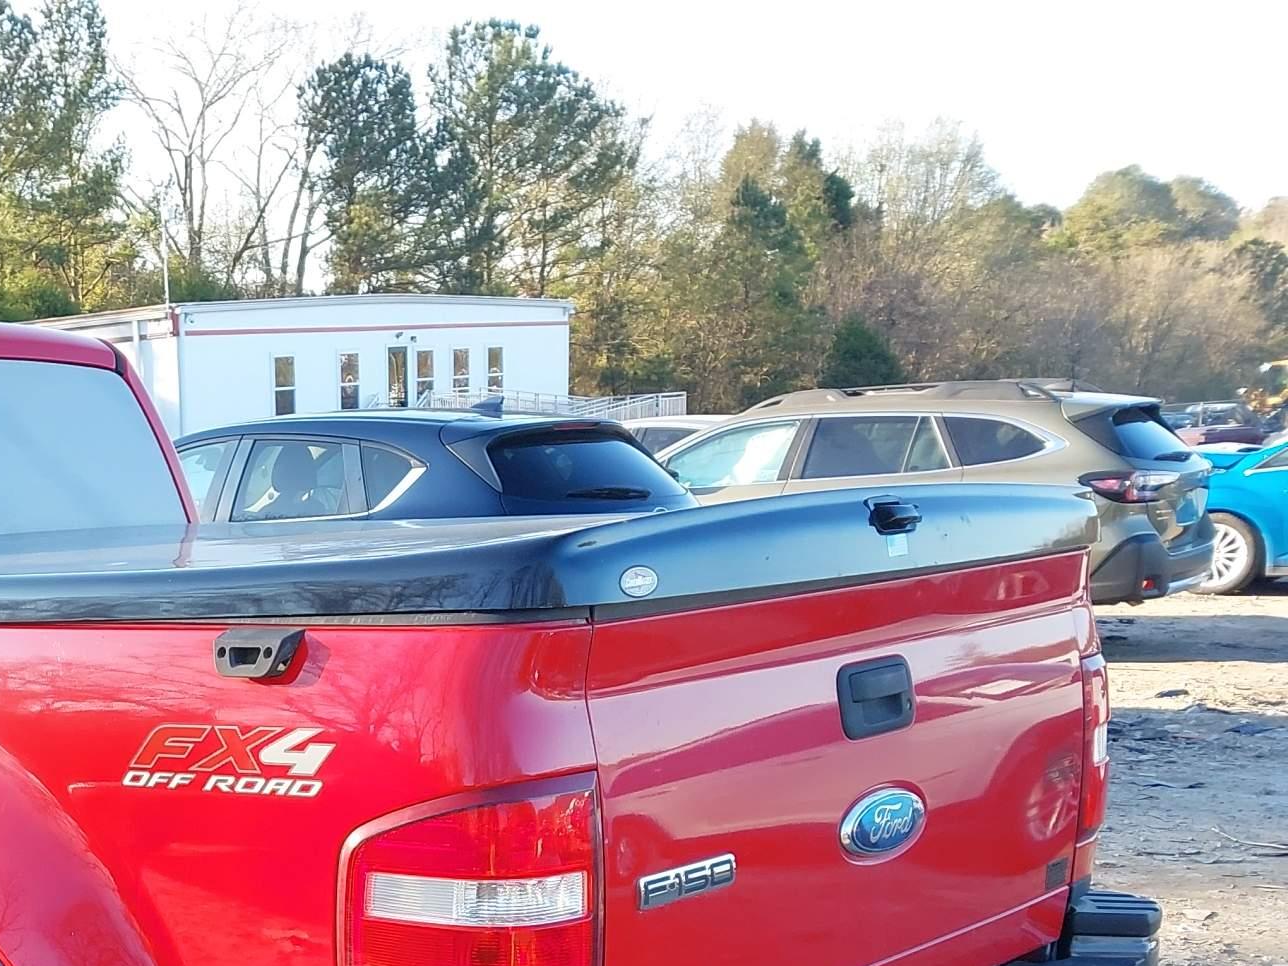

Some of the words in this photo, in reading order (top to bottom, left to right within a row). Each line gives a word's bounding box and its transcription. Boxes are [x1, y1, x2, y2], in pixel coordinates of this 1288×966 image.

[128, 724, 337, 776] FX4
[121, 770, 197, 790] OFF
[202, 775, 324, 799] ROAD
[869, 804, 914, 843] Ford
[641, 856, 735, 907] F-150
